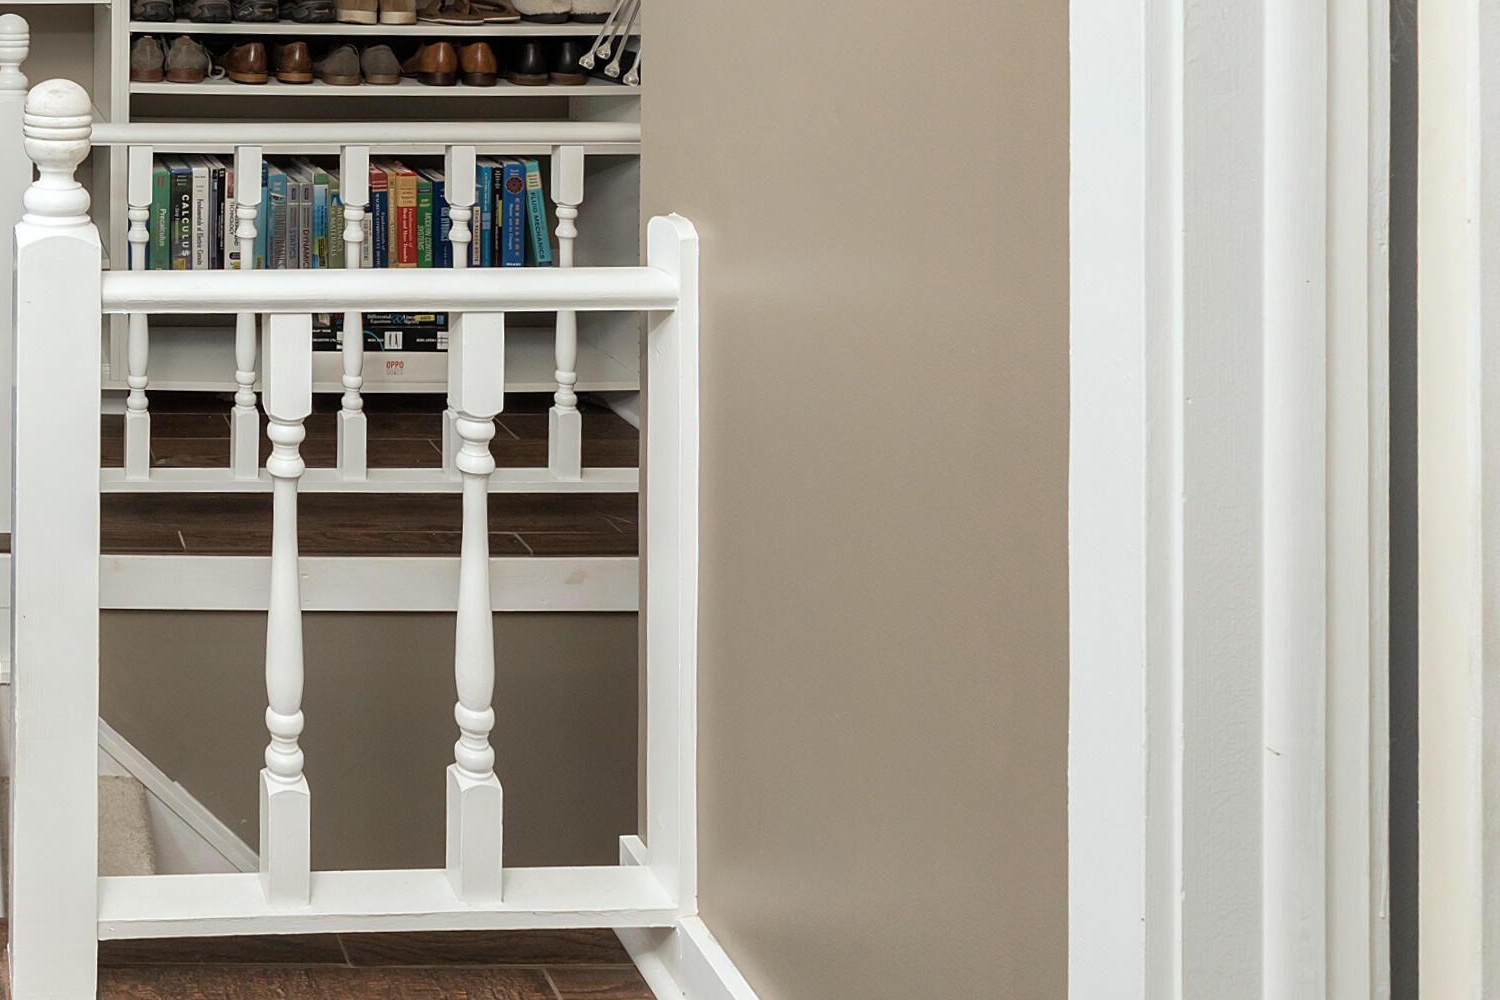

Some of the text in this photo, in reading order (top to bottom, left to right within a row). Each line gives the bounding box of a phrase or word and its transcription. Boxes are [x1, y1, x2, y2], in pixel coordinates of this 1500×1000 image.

[181, 194, 190, 257] CALCULUS
[302, 229, 310, 268] DYNAMIC
[530, 191, 538, 213] FLUID
[534, 215, 545, 259] MECHANICS
